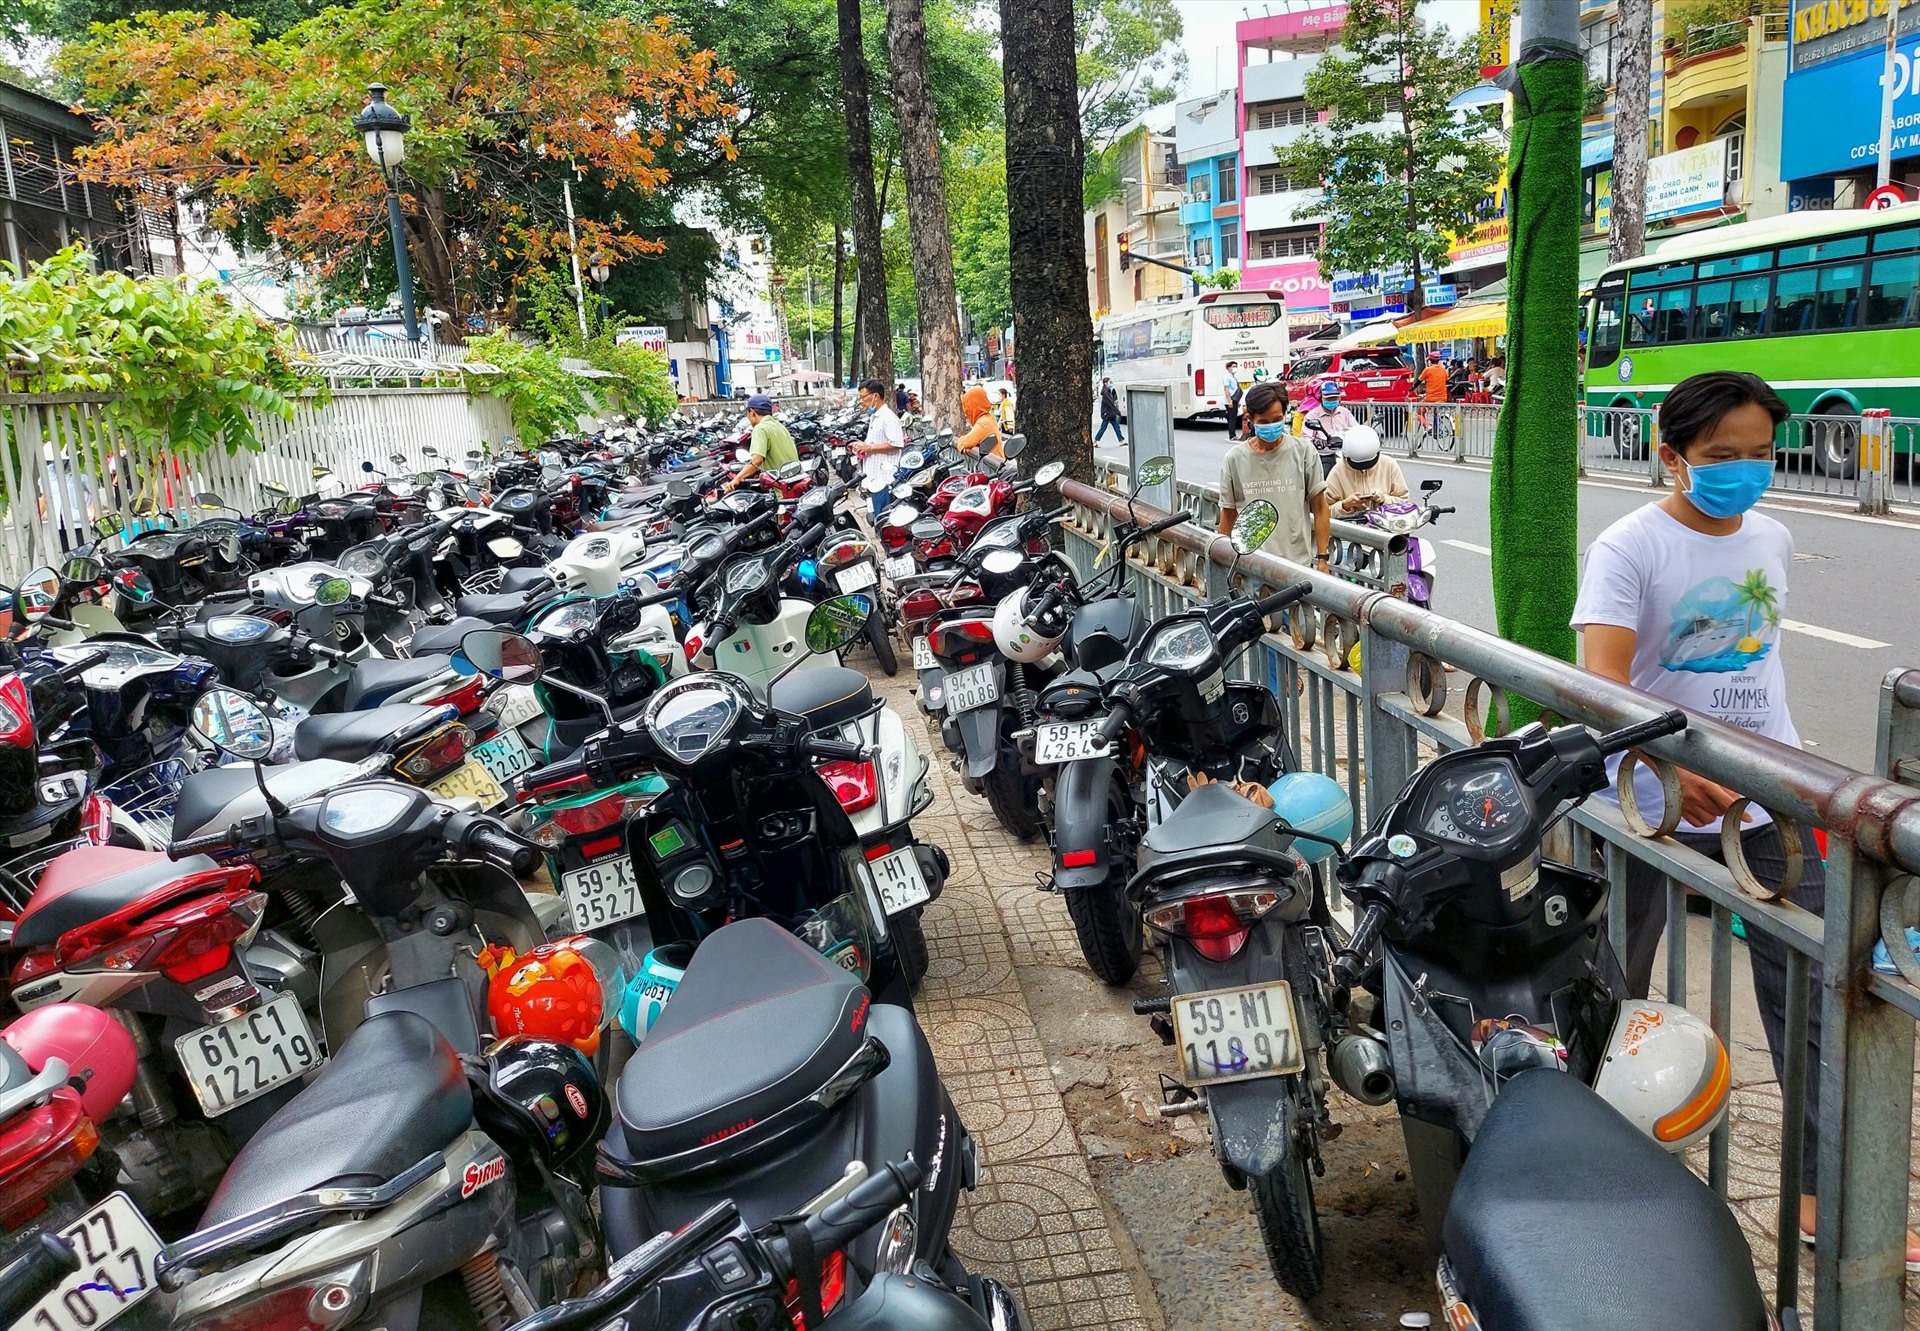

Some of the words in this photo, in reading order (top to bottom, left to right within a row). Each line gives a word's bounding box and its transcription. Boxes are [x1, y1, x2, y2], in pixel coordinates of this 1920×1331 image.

[1332, 303, 1349, 313] 630
[1385, 295, 1403, 305] 630
[1243, 487, 1275, 495] OMETHING
[951, 669, 987, 692] 94-K1
[1730, 675, 1757, 683] HAPPY
[950, 683, 995, 712] 180.86
[1710, 687, 1770, 710] SUMMER
[1042, 740, 1098, 759] 426.4
[487, 748, 527, 782] 12.07
[591, 852, 619, 863] HONDA
[878, 855, 906, 882] -H1
[575, 886, 635, 928] 352.7
[631, 977, 673, 1003] LEOPARD
[1189, 990, 1273, 1035] 59-N1
[198, 1004, 288, 1069] 61-C1
[1185, 1028, 1291, 1079] 118.97
[205, 1034, 313, 1107] 122.19
[701, 1118, 756, 1145] YAMAHA
